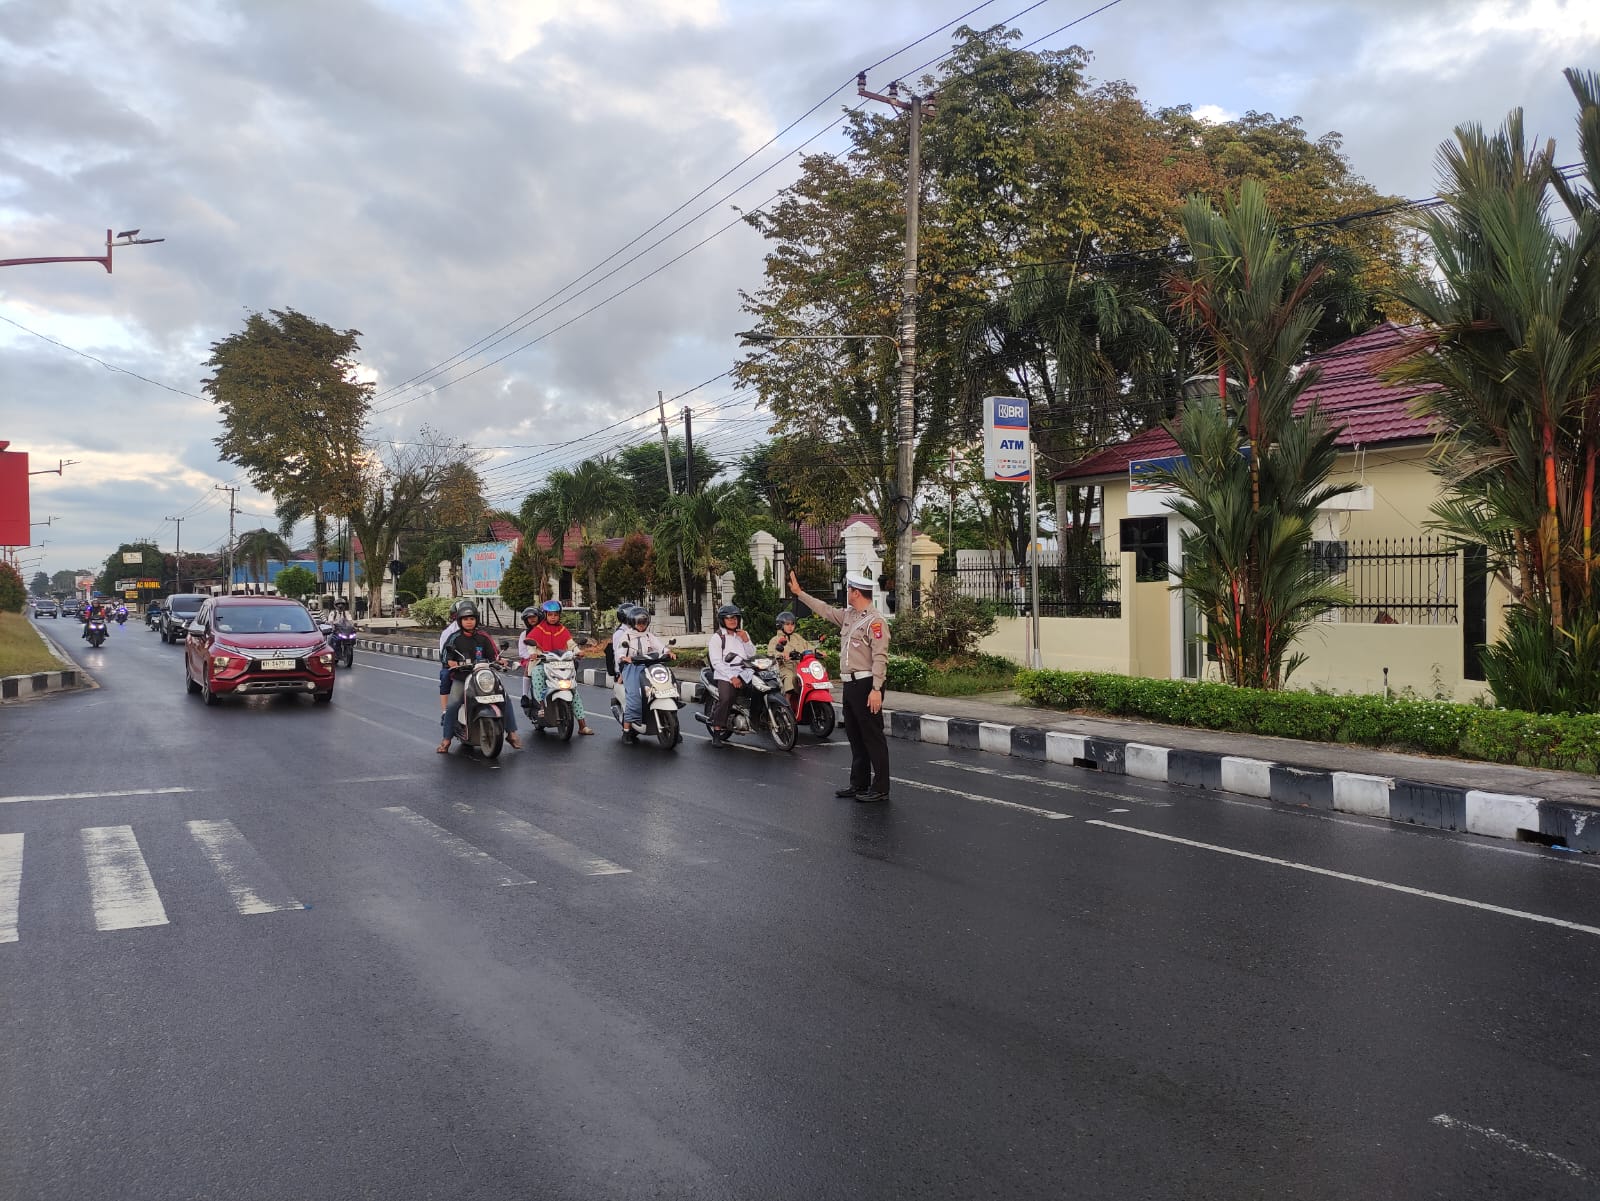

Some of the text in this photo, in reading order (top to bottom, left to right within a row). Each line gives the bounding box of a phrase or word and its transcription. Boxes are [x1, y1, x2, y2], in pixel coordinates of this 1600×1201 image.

[1008, 406, 1024, 418] BRI
[1000, 439, 1024, 450] ATM
[136, 581, 143, 589] AC
